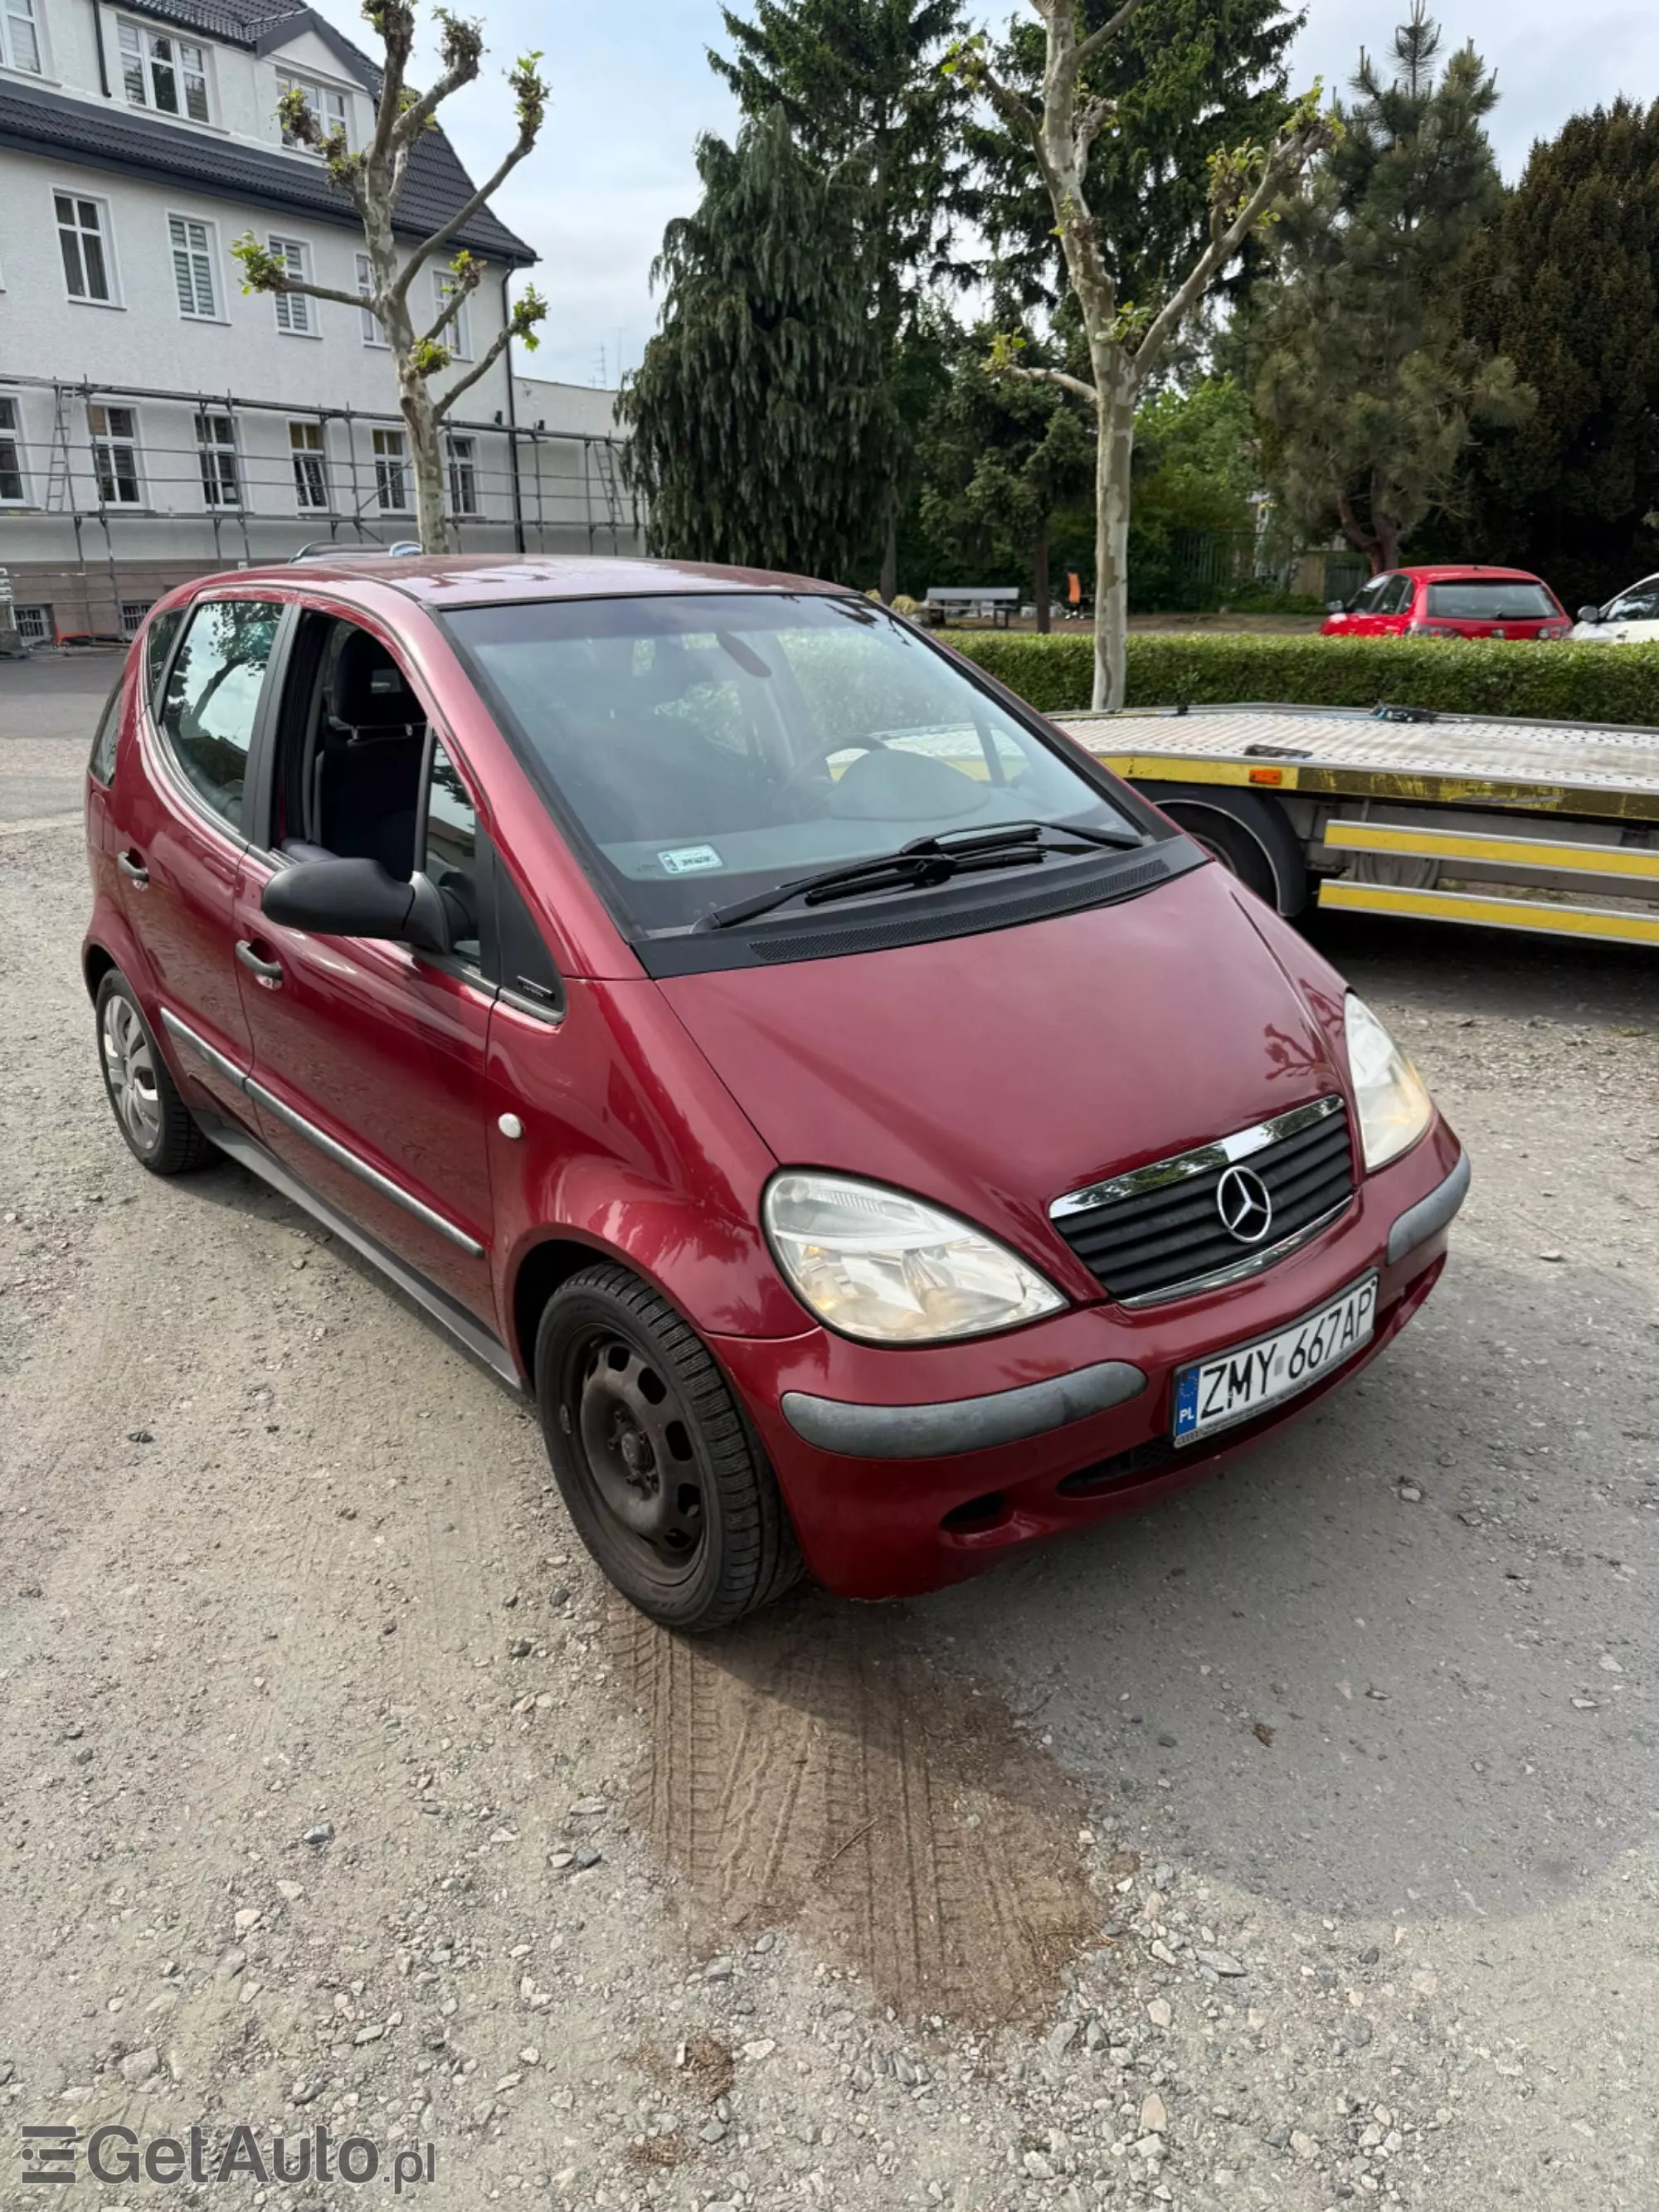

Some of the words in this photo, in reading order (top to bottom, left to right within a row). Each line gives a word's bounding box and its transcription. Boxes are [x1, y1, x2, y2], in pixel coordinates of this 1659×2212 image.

[1200, 1343, 1277, 1419] ZMY
[1288, 1287, 1372, 1379] 667AP
[1179, 1407, 1195, 1423] PL
